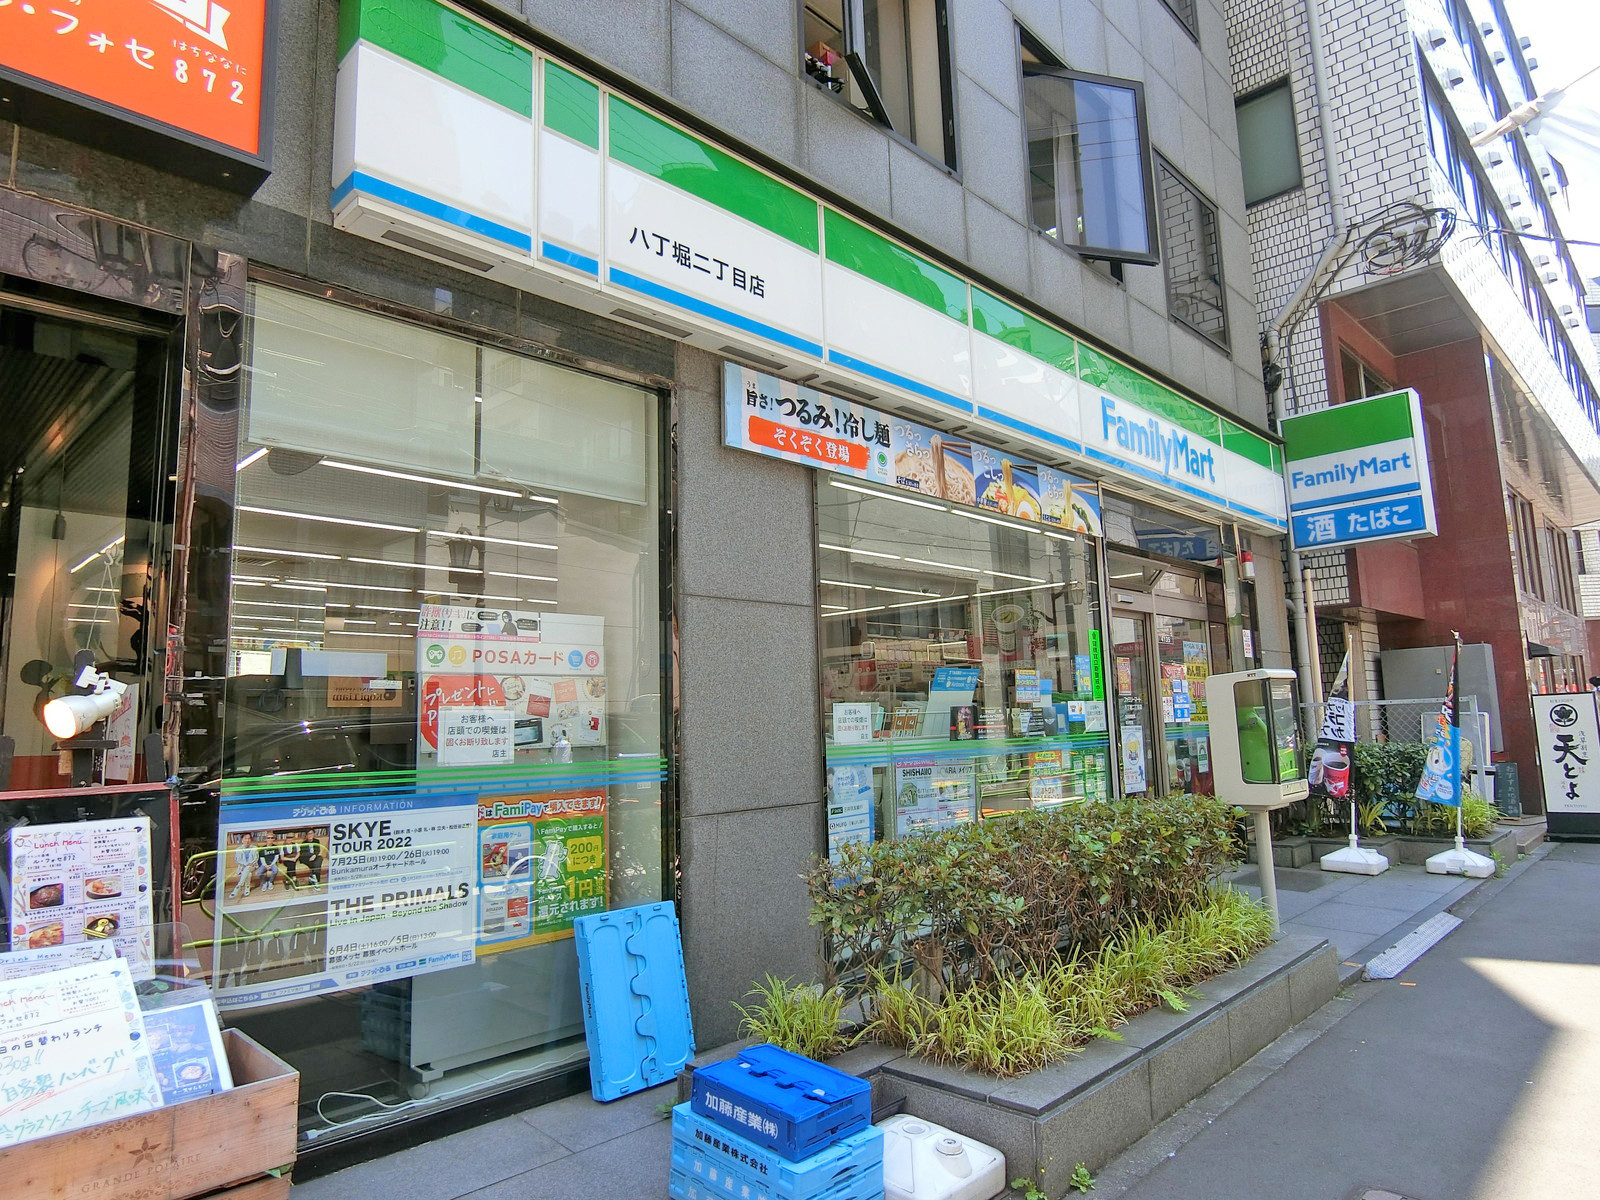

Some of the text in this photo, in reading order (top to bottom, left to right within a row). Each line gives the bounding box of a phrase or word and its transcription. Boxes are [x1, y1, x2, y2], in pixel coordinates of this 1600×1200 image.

[173, 39, 247, 76] はちななに
[174, 59, 244, 105] 872
[629, 227, 765, 299] 八丁堀二丁目店
[894, 424, 922, 442] つるっ
[1101, 396, 1216, 484] FamilyMart
[773, 427, 850, 463] ぞくぞく登場
[973, 449, 997, 464] つるっ
[1292, 452, 1411, 489] FamilyMart
[1307, 505, 1413, 543] 酒 たばこ
[472, 649, 564, 666] POSAカード
[461, 714, 495, 724] お客様へ
[448, 726, 507, 735] 店頭での喫煙は
[446, 737, 508, 747] 固くお断り致します
[492, 749, 507, 758] 店主
[1552, 734, 1591, 801] 天とよ
[340, 801, 413, 814] INFORMATION
[333, 820, 392, 841] SKYE
[332, 836, 412, 854] TOUR 2022
[331, 860, 427, 876] Bunkamuraオーチャードホール
[573, 855, 596, 866] につき
[331, 882, 470, 917] THE PRIMALS
[329, 900, 468, 927] Live in Japan Beyond the Shadow
[428, 953, 460, 964] FamilyMart
[705, 1092, 779, 1140] 加藤産業(株)
[695, 1129, 769, 1176] 加藤産業株式会社
[81, 1171, 143, 1194] GRANDE
